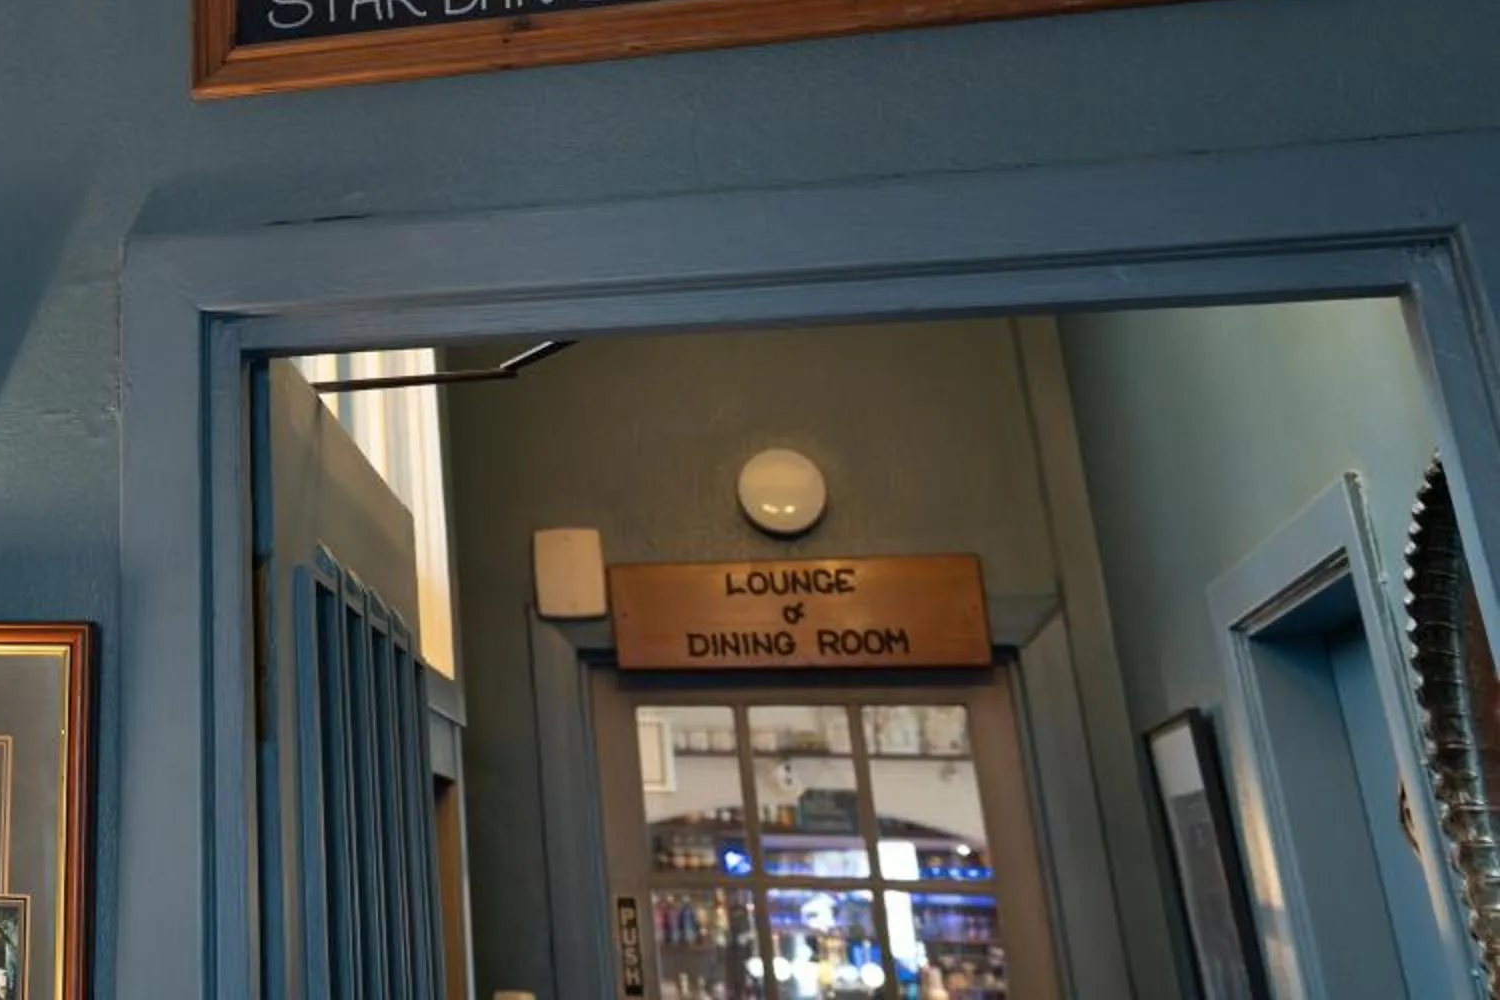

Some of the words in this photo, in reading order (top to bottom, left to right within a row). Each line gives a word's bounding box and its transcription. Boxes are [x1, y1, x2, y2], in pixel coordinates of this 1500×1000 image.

[725, 568, 856, 596] LOUNGE
[686, 631, 796, 658] DINING
[816, 626, 910, 656] ROOM
[620, 907, 640, 986] PUSH
